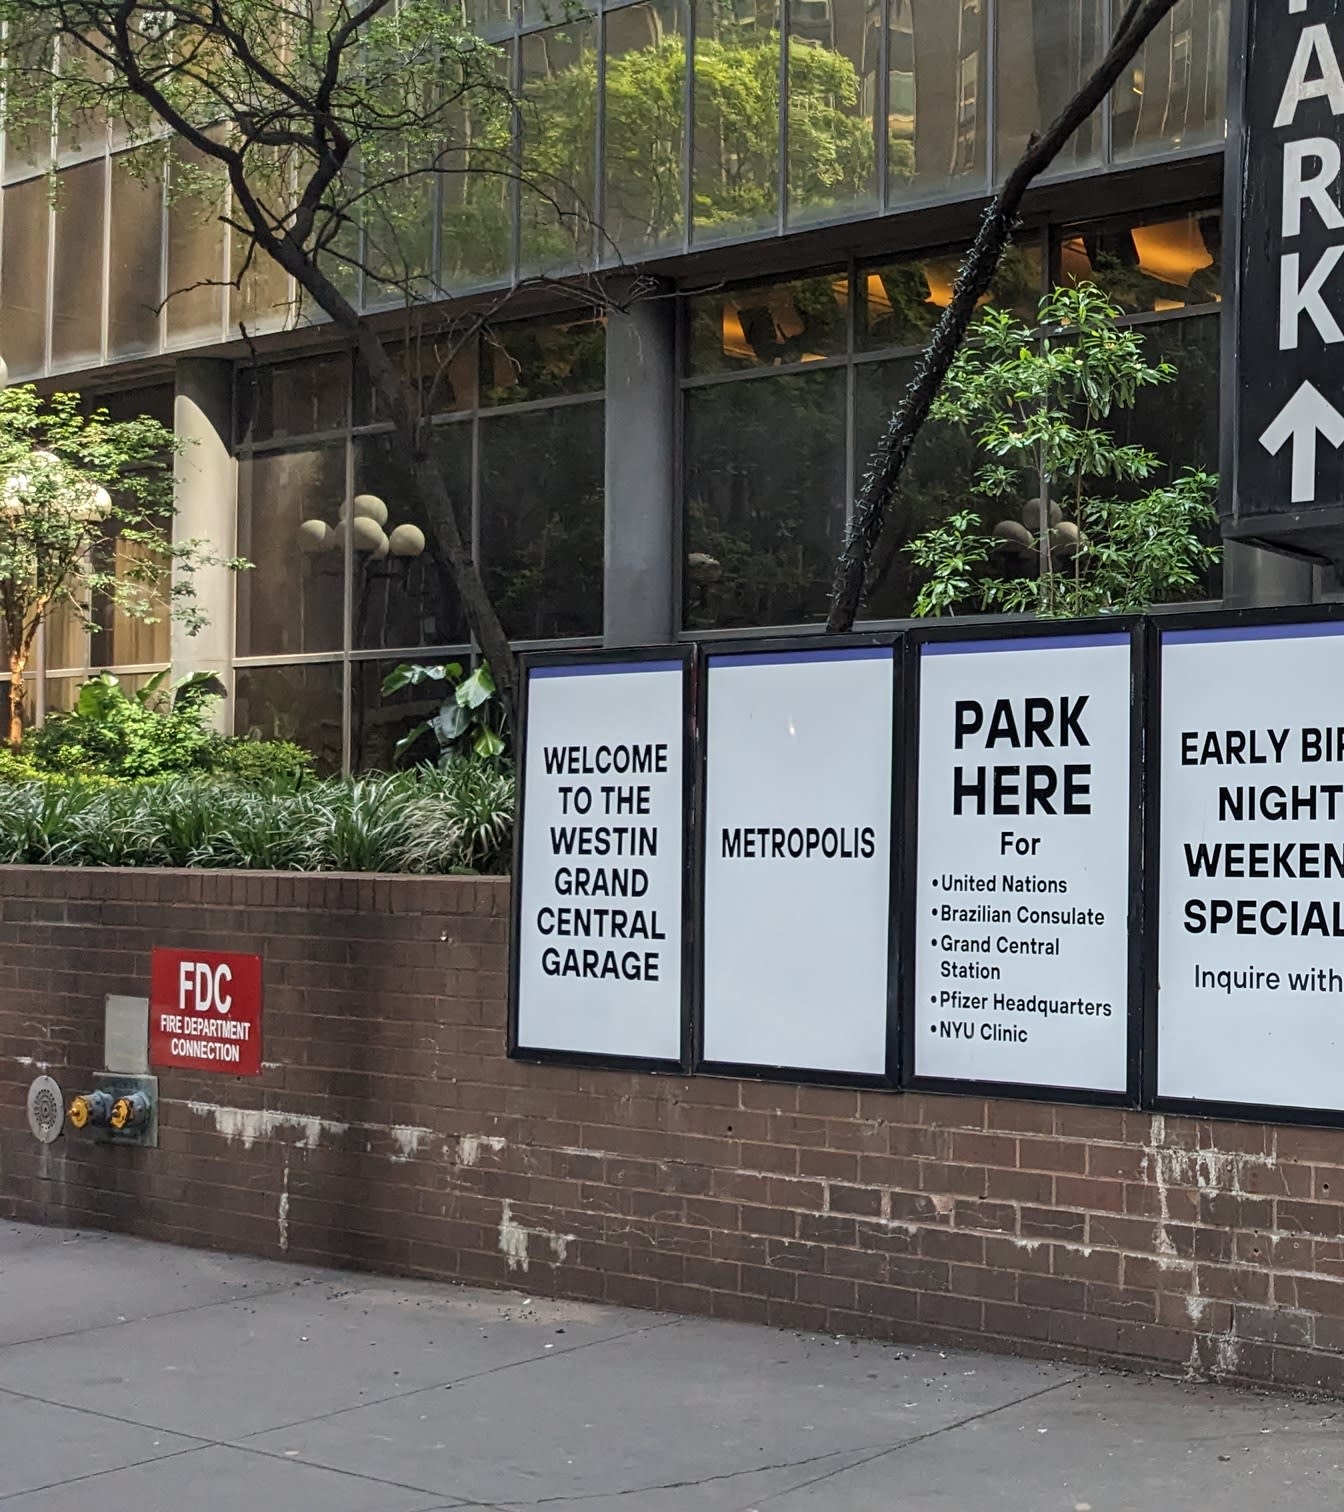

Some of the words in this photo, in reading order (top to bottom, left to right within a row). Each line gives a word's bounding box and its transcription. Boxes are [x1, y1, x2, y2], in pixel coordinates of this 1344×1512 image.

[954, 695, 1091, 750] PARK
[543, 743, 668, 774] WELCOME
[1181, 728, 1290, 766] EARLY
[558, 786, 592, 815] TO
[600, 786, 651, 815] THE
[953, 764, 1092, 816] HERE
[1218, 785, 1344, 822] NIGHT
[550, 827, 658, 857] WESTIN
[721, 827, 876, 859] METROPOLIS
[999, 831, 1041, 856] For
[554, 867, 649, 897] GRAND
[941, 874, 996, 892] United
[1002, 875, 1068, 893] Nations
[536, 907, 666, 940] CENTRAL
[941, 904, 1011, 923] Brazilian
[1017, 906, 1105, 925] Consulate
[941, 934, 991, 953] Grand
[996, 936, 1060, 956] Central
[541, 947, 660, 982] GARAGE
[941, 960, 1000, 980] Station
[1194, 964, 1280, 995] Inquire
[179, 961, 232, 1014] FDC
[940, 990, 988, 1010] Pfizer
[993, 993, 1112, 1018] Headquarters
[160, 1014, 182, 1034] FIRE
[184, 1018, 250, 1041] DEPARTMENT
[940, 1021, 975, 1039] NYU
[980, 1023, 1028, 1043] Clinic
[171, 1038, 240, 1063] CONNECTION
